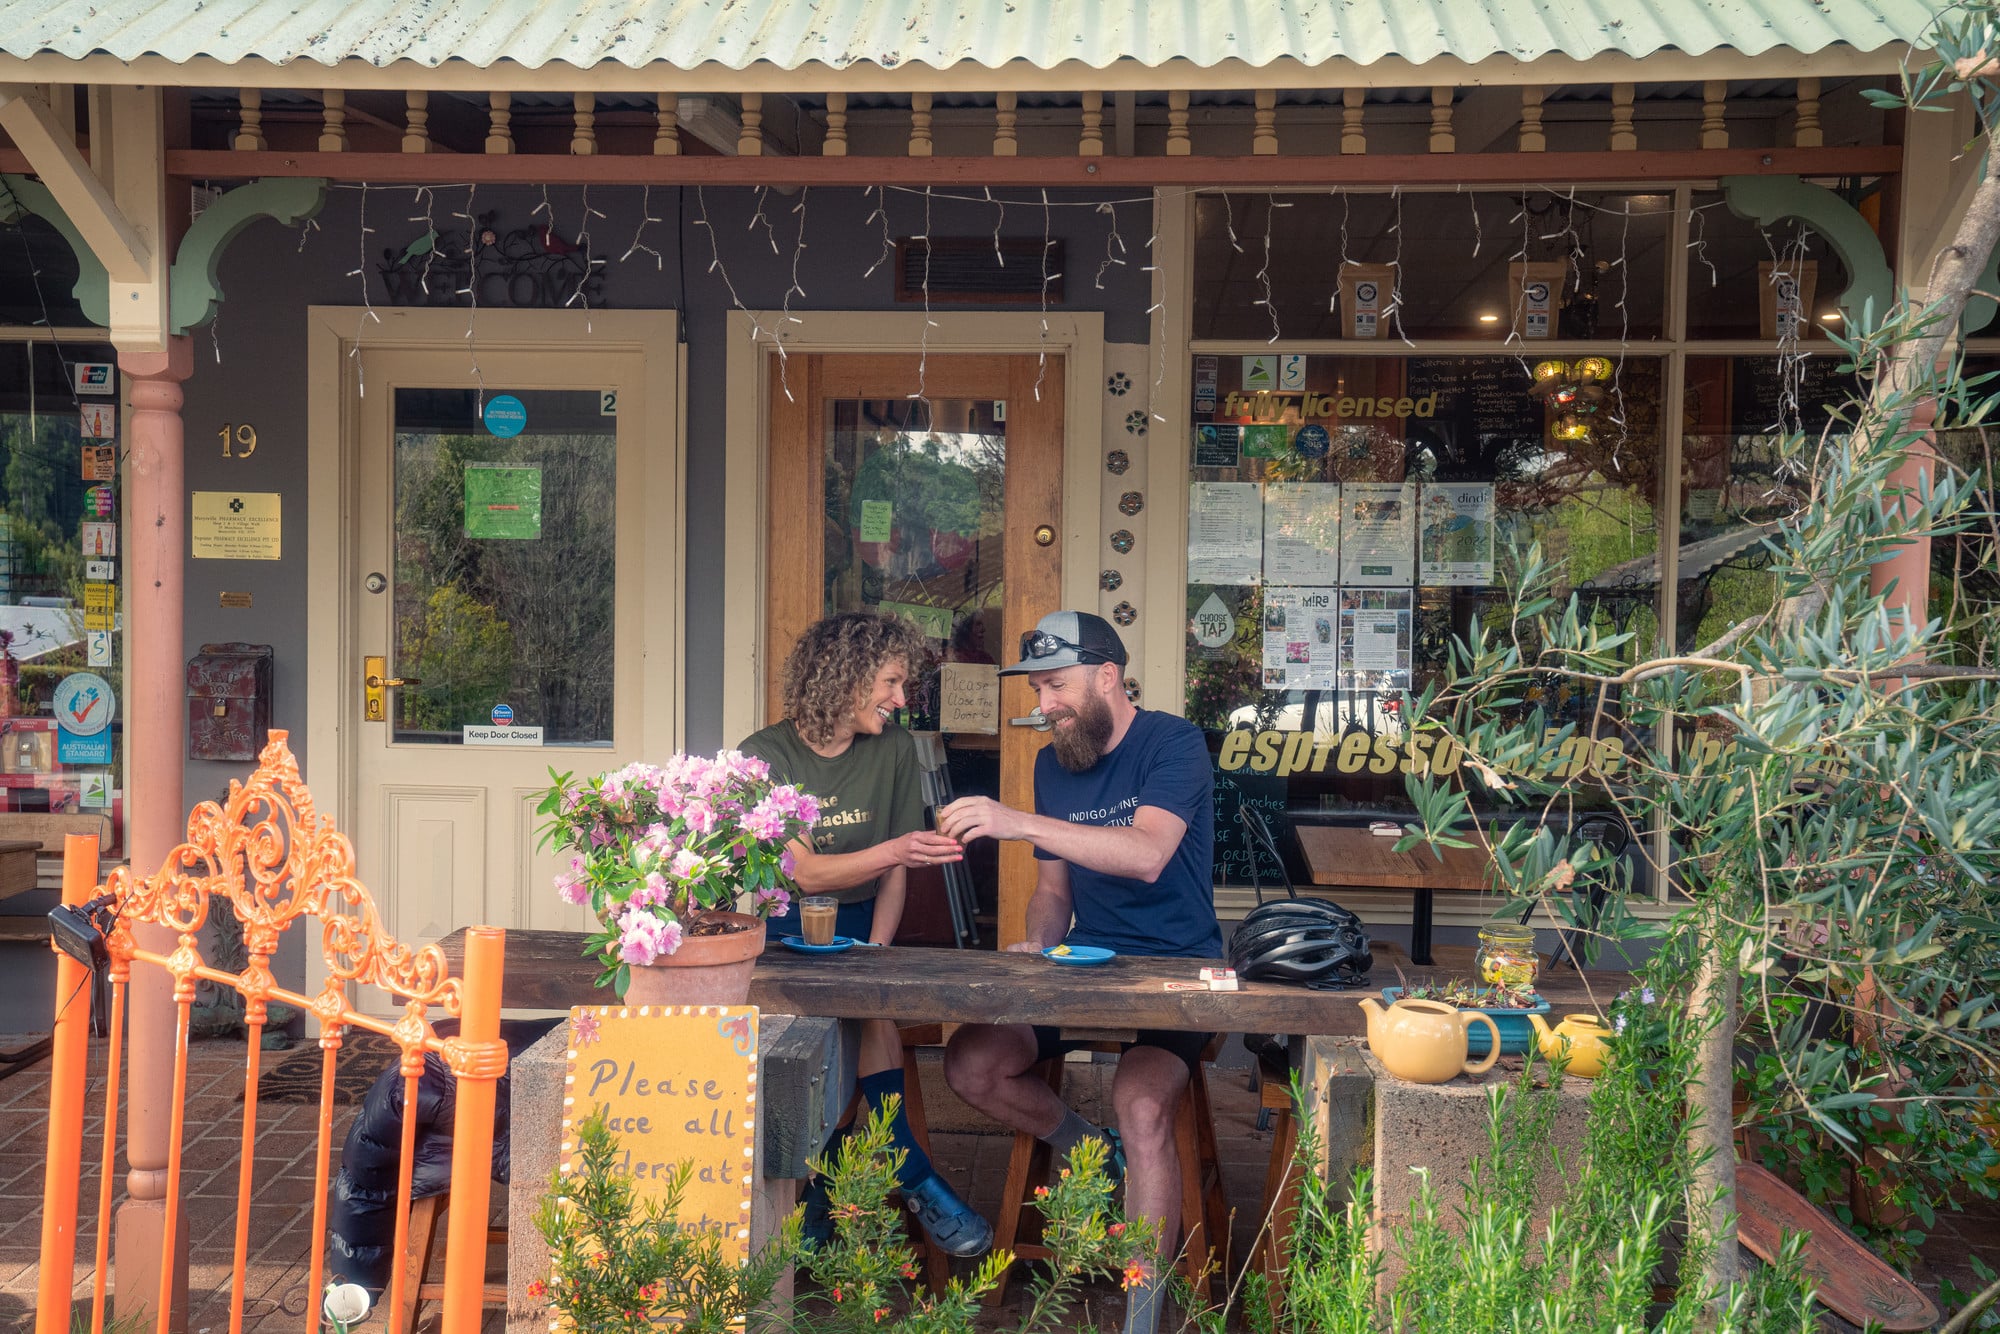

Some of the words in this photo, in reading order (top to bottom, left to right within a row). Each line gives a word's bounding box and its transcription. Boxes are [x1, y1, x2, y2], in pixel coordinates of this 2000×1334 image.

[378, 270, 607, 308] WELCOME
[603, 394, 616, 412] 2
[995, 402, 1003, 418] 1
[1224, 391, 1290, 420] fully
[1299, 391, 1438, 418] licensed
[218, 423, 257, 459] 19
[1457, 492, 1487, 503] dindi
[1199, 613, 1228, 622] CHOOSE
[1199, 622, 1228, 638] TAP
[944, 668, 989, 691] Please
[947, 692, 974, 706] Close
[953, 708, 978, 720] Door
[468, 730, 489, 739] Keep
[490, 730, 510, 739] Door
[511, 731, 538, 739] Closed
[62, 743, 108, 751] AUSTRALIAN
[1218, 729, 1464, 777] espresso
[1238, 791, 1285, 810] lunches
[1069, 808, 1107, 822] INDIGO
[588, 1058, 725, 1100] Please
[684, 1109, 737, 1139] all
[699, 1159, 734, 1185] at
